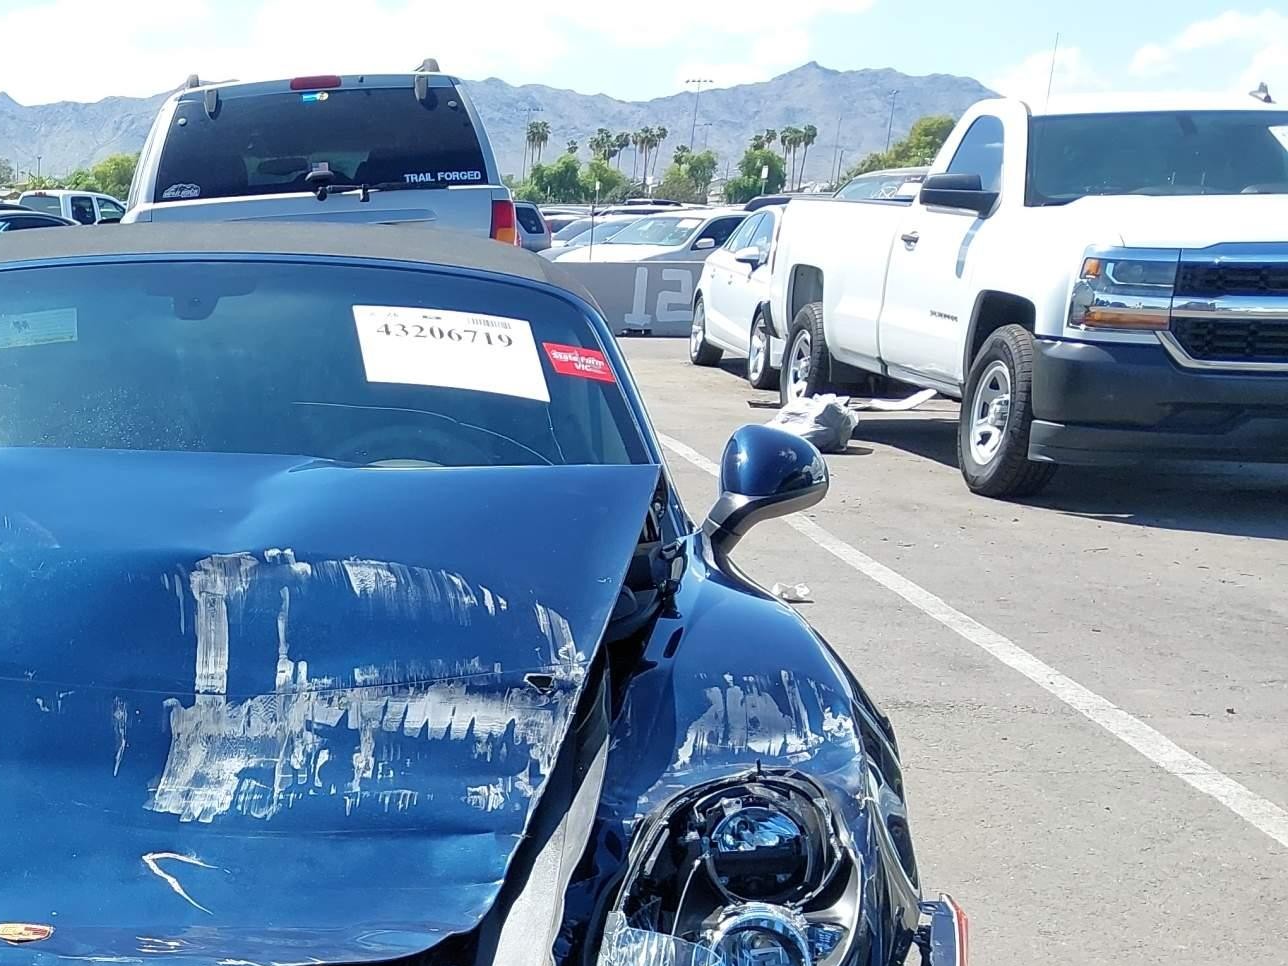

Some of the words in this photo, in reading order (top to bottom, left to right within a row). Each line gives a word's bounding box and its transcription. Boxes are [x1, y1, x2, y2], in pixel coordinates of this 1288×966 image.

[404, 172, 435, 183] TRAIL
[437, 170, 482, 181] FORGED
[624, 265, 693, 327] 12
[376, 322, 513, 347] 43206719
